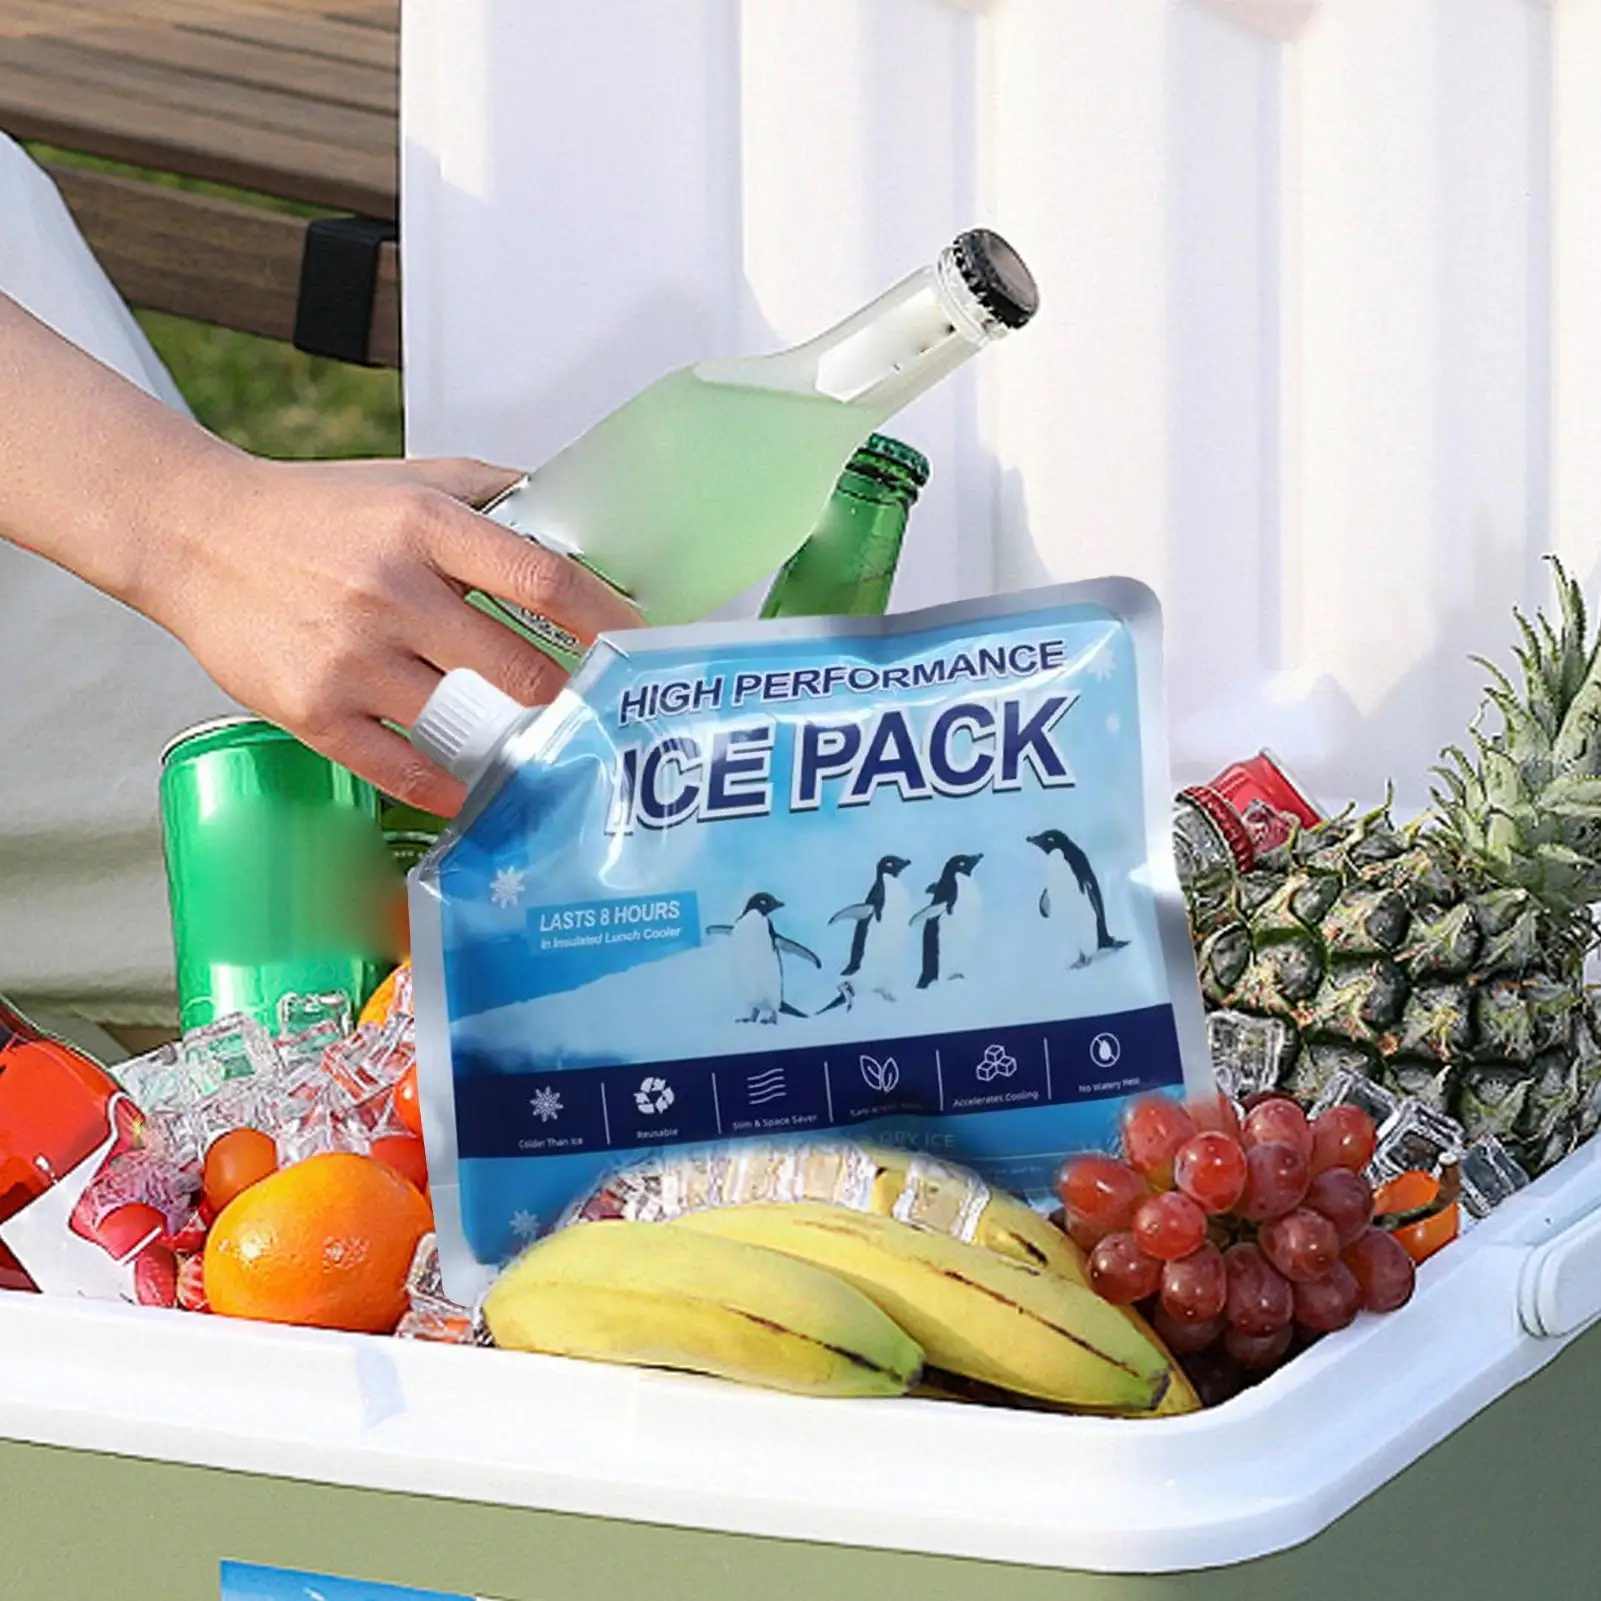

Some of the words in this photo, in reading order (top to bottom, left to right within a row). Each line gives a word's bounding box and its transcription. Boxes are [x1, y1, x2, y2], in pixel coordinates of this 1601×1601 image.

[619, 677, 722, 726] HIGH
[733, 640, 1065, 705] PERFORMANCE
[605, 720, 776, 835] ICE
[790, 694, 1080, 814] PACK
[540, 909, 596, 932] LASTS
[600, 908, 611, 926] 8
[614, 900, 681, 925] HOURS
[553, 933, 603, 948] Insulated
[605, 929, 641, 944] Lunch
[643, 926, 682, 940] Cooler
[1079, 1084, 1092, 1093] No
[1093, 1080, 1122, 1092] Watery
[953, 1093, 1003, 1108] Accelerates
[1004, 1089, 1039, 1102] Cooling
[636, 1127, 679, 1139] Reusable
[924, 1132, 955, 1148] ICE
[518, 1138, 545, 1149] Colder
[546, 1137, 569, 1147] Than
